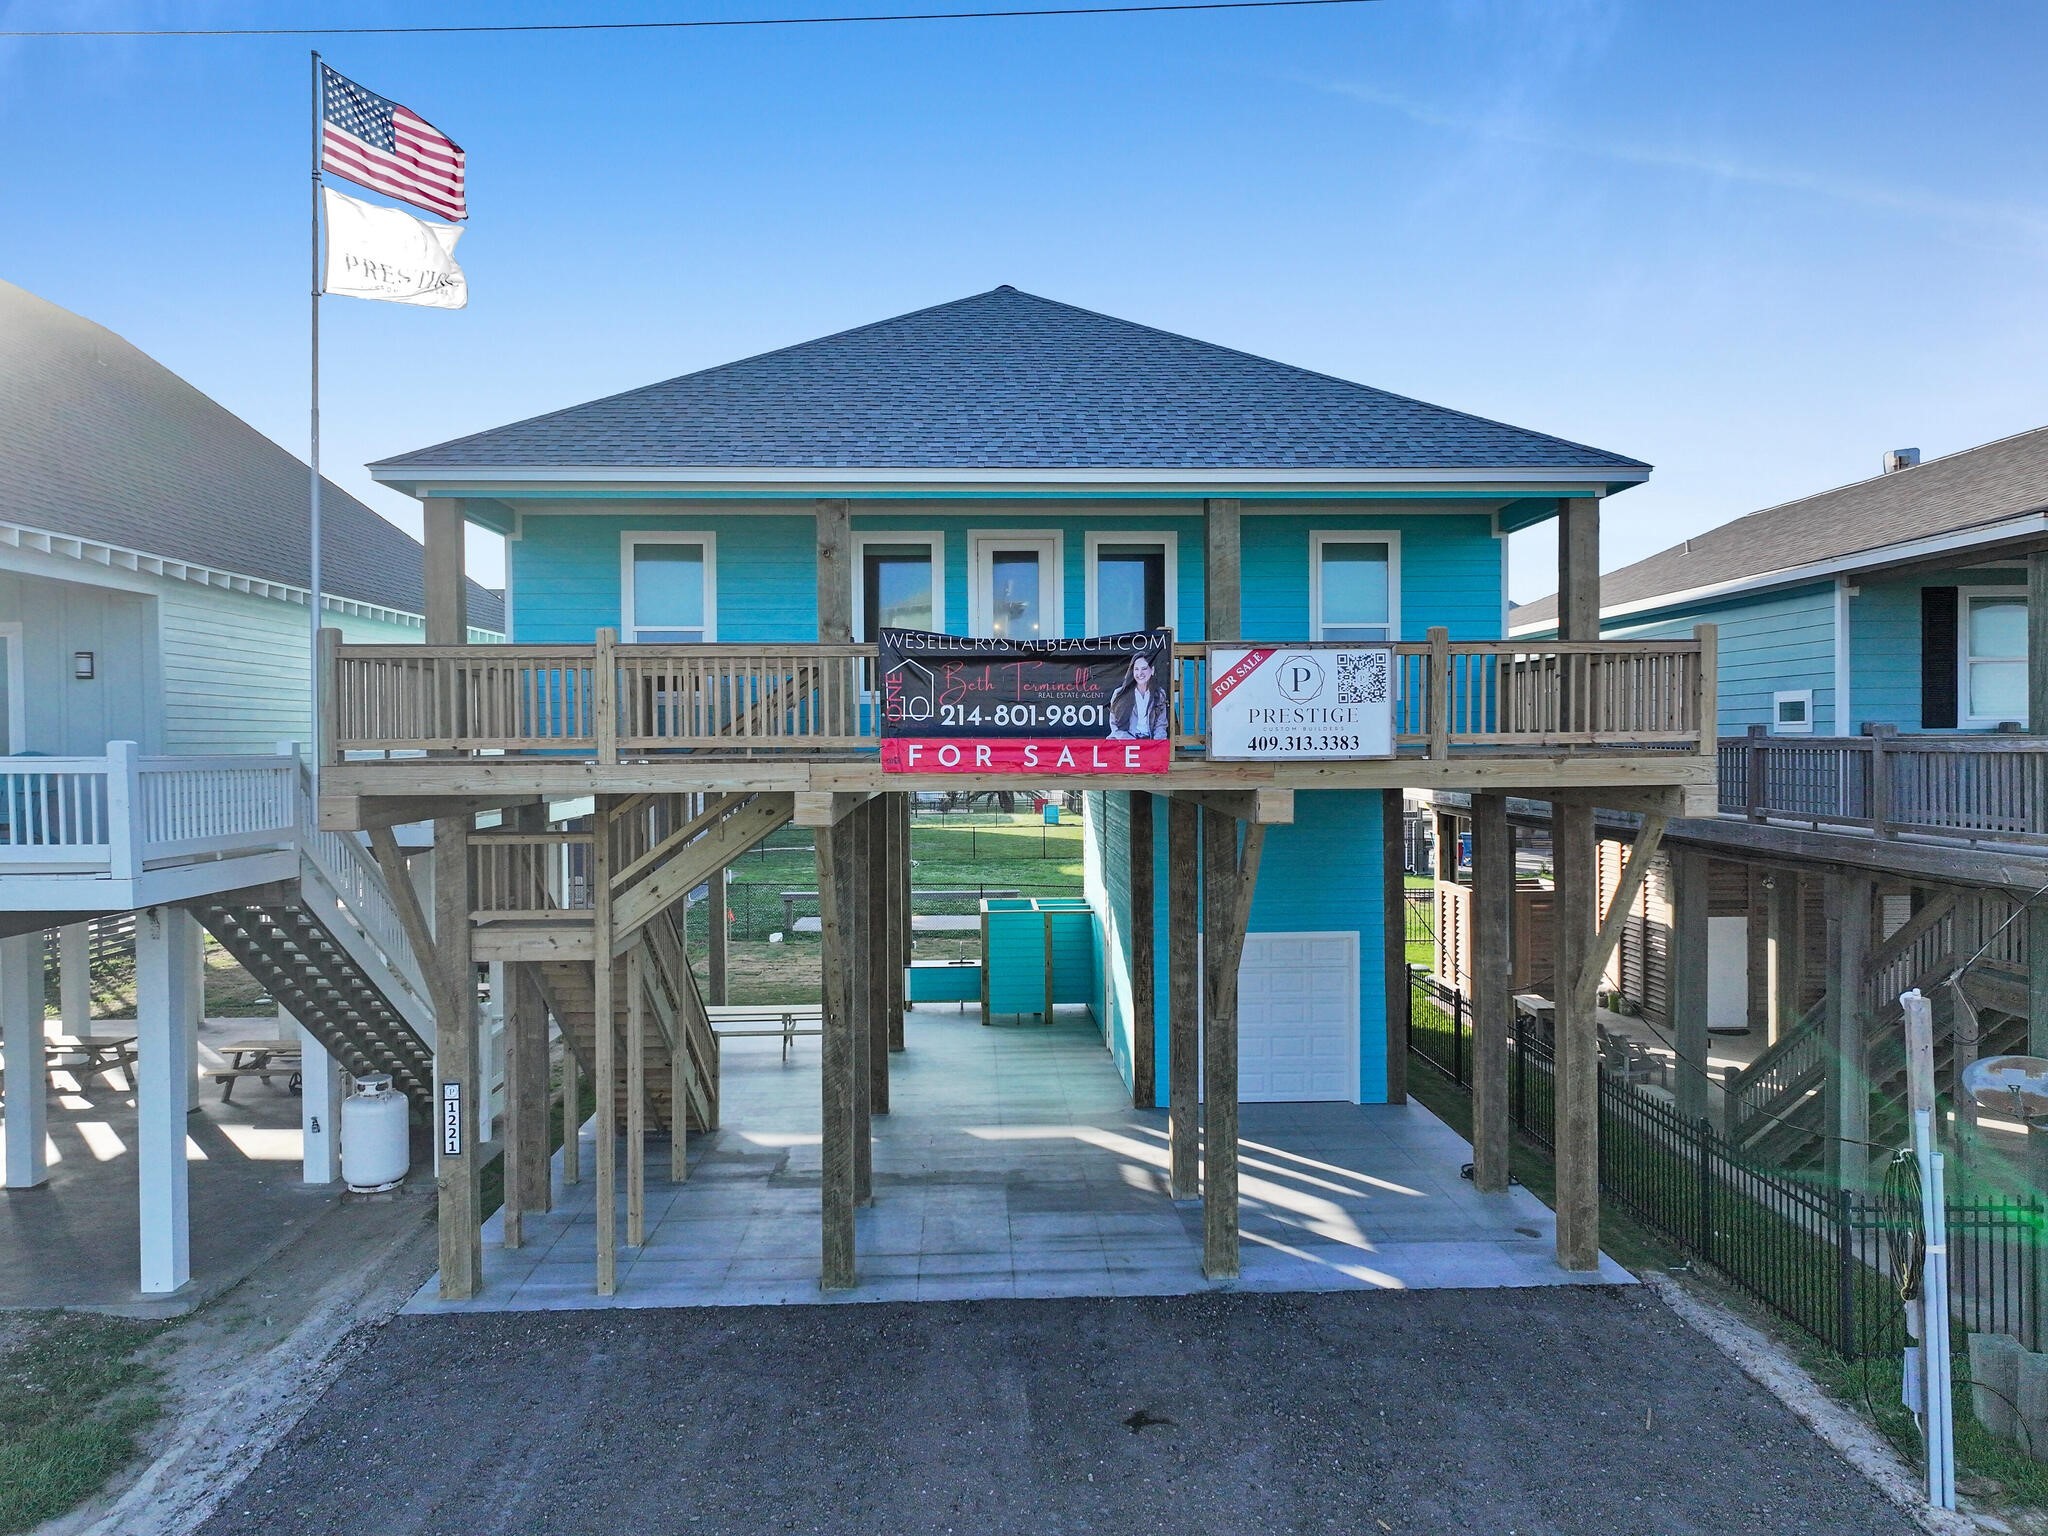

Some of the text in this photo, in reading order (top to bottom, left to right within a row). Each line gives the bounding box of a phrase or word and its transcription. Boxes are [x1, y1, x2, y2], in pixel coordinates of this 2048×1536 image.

[882, 631, 1167, 651] WESELLCRYSTALBEACH.COM
[939, 660, 1100, 706] Beth Terminella
[1214, 652, 1264, 697] FOR SALE
[1292, 667, 1311, 692] P
[885, 672, 903, 722] ONE
[940, 704, 1103, 727] 214-801-9801
[1249, 708, 1359, 724] PRESTIGE
[1247, 735, 1359, 751] 409.313.3383
[908, 744, 1141, 768] FOR SALE
[448, 1101, 457, 1152] 1221
